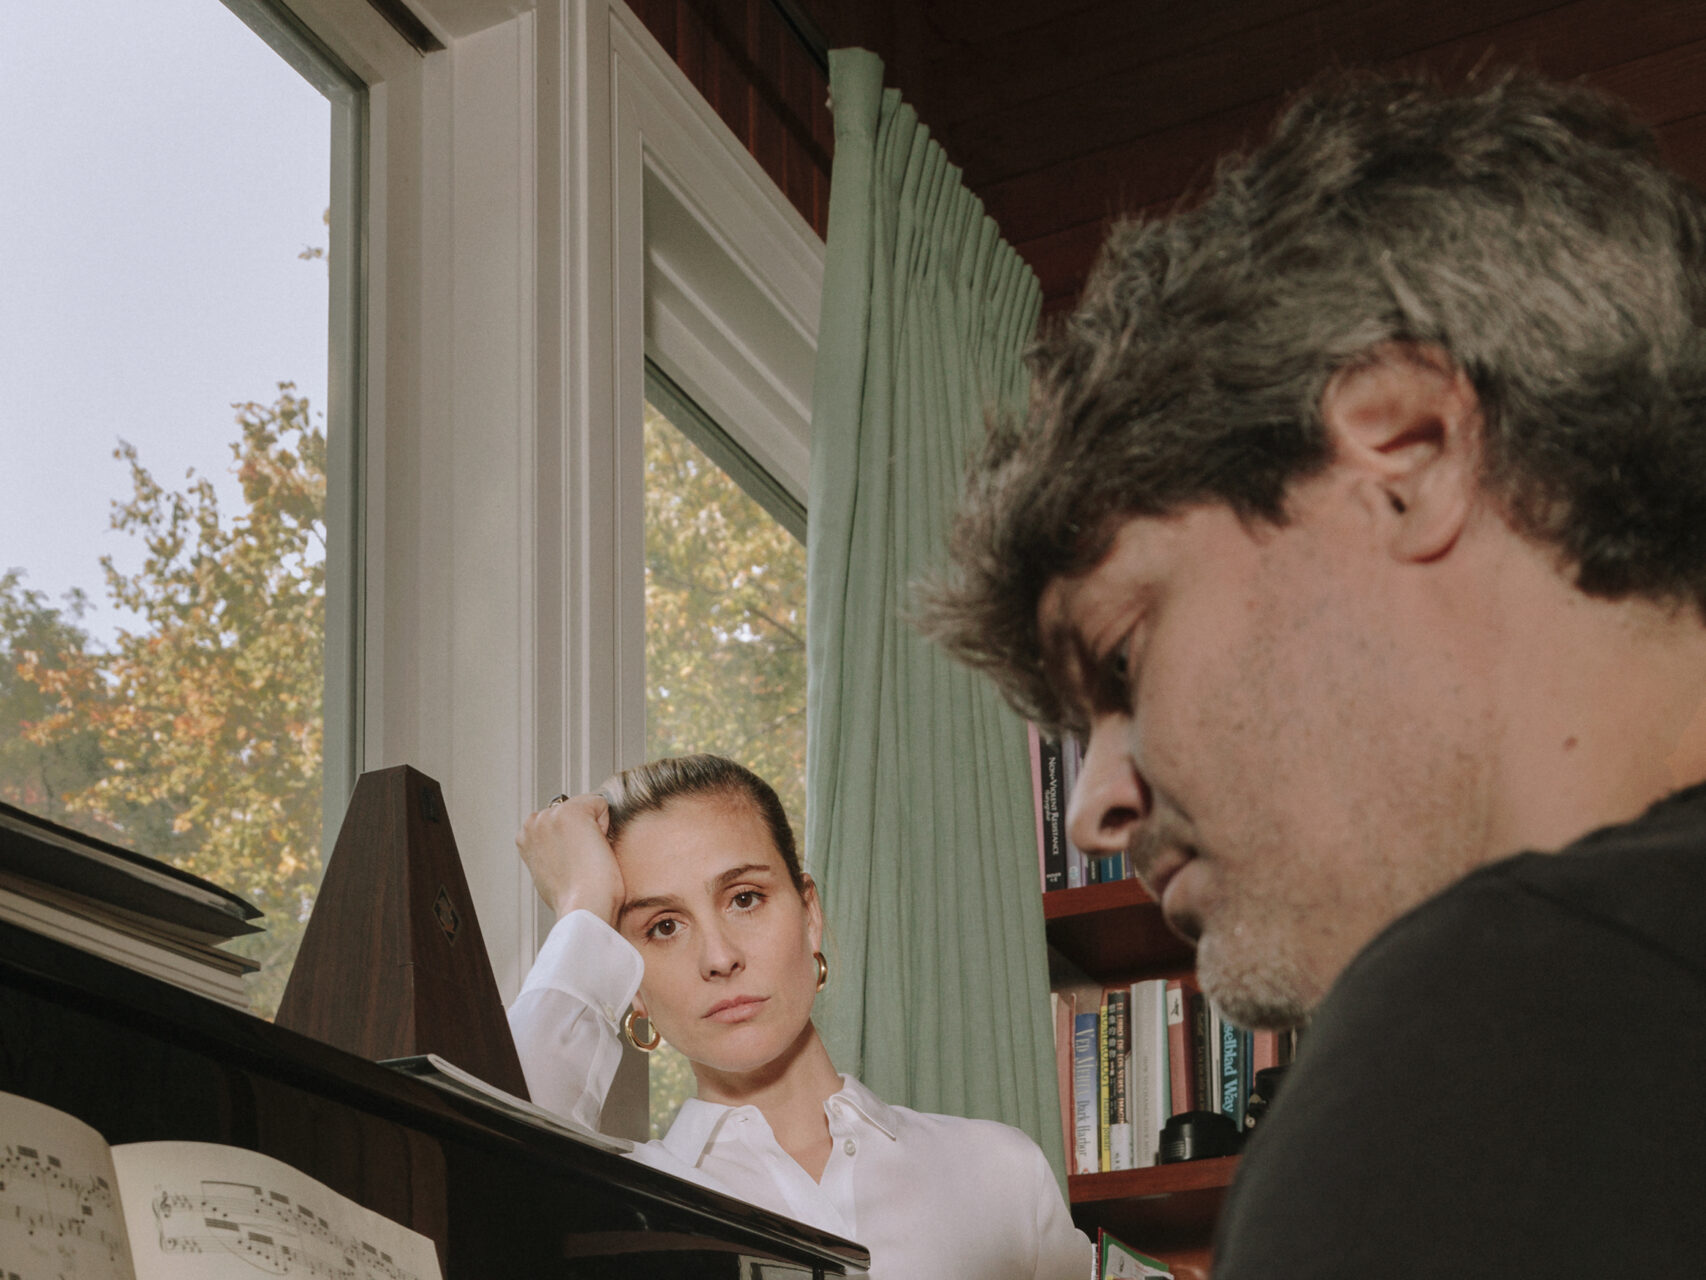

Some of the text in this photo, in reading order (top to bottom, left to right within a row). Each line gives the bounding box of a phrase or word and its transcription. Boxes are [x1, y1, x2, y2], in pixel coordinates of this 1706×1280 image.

[1051, 811, 1061, 855] RESISTANCE
[1076, 1028, 1095, 1053] VED
[1222, 1079, 1238, 1112] Way
[1077, 1100, 1092, 1157] Dark Harbor
